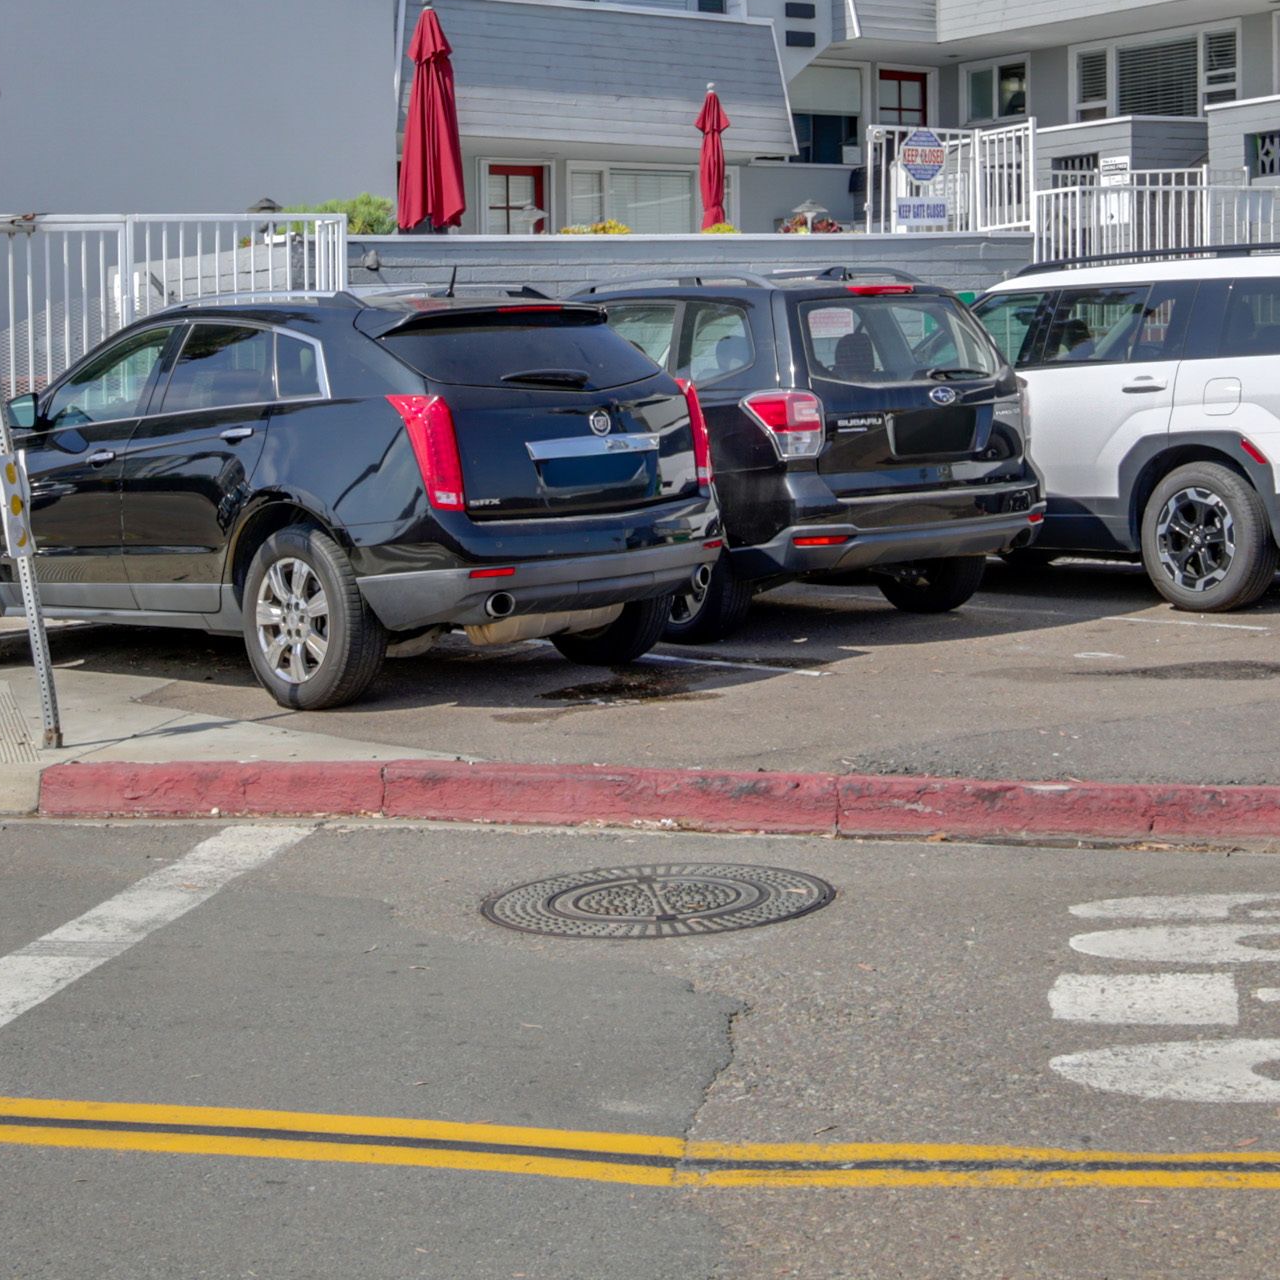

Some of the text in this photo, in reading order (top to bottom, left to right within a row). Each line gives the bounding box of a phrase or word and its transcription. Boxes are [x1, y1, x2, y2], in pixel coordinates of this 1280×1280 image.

[903, 148, 944, 163] KEEP CLOSED
[899, 204, 946, 219] KEEP GATE CLOSED
[837, 418, 882, 427] SUBARU
[470, 498, 501, 506] SRX
